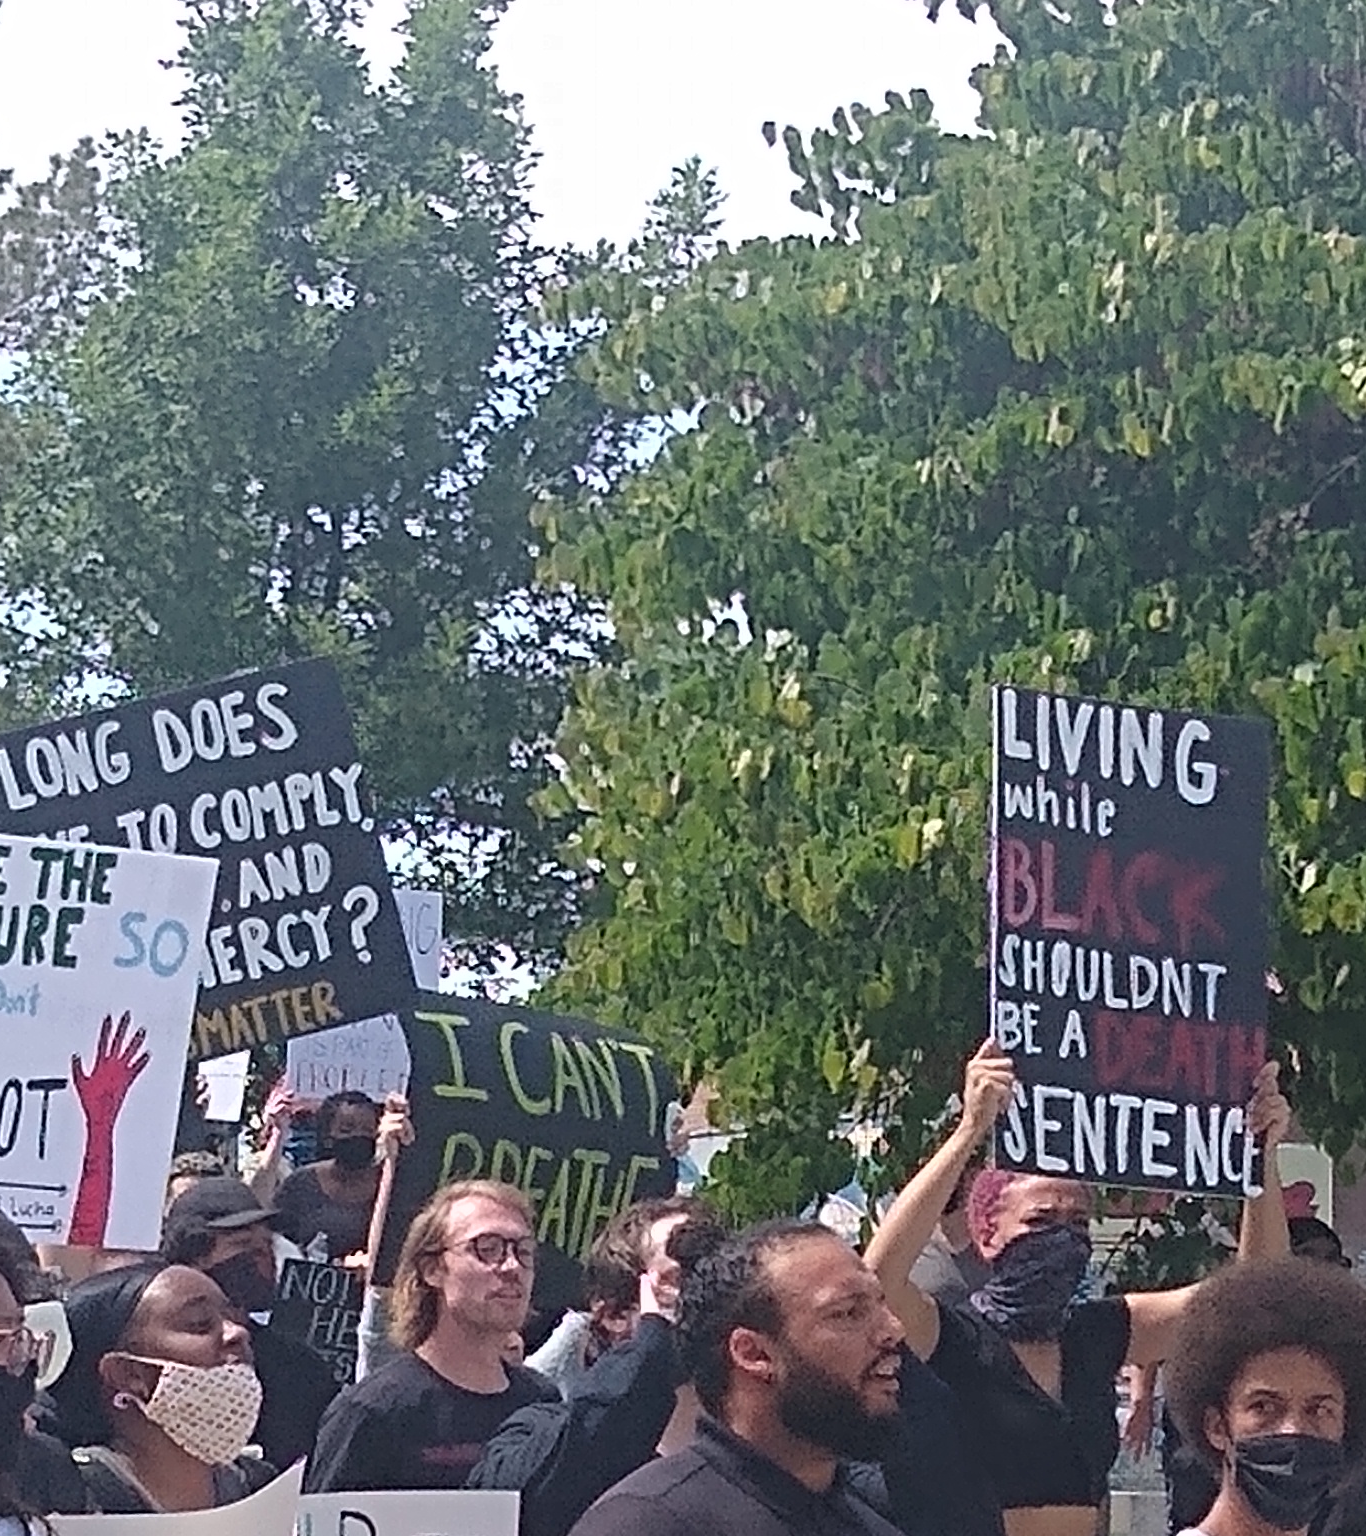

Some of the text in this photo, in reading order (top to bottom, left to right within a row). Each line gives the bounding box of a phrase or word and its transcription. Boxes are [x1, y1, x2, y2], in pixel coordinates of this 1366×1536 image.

[152, 683, 299, 773] DOES
[1002, 688, 1218, 804] LIVING
[117, 762, 375, 854] TO COMPLY.
[1004, 774, 1117, 837] while
[31, 846, 119, 904] THE
[239, 842, 332, 908] AND
[1002, 838, 1227, 956] BLACK
[113, 911, 189, 977] SO
[998, 934, 1228, 1021] SHOULDNT
[196, 980, 344, 1057] MATTER
[414, 1010, 489, 1101] I
[997, 1001, 1267, 1102] BE A DEATH
[1002, 1080, 1264, 1198] SENTENCE
